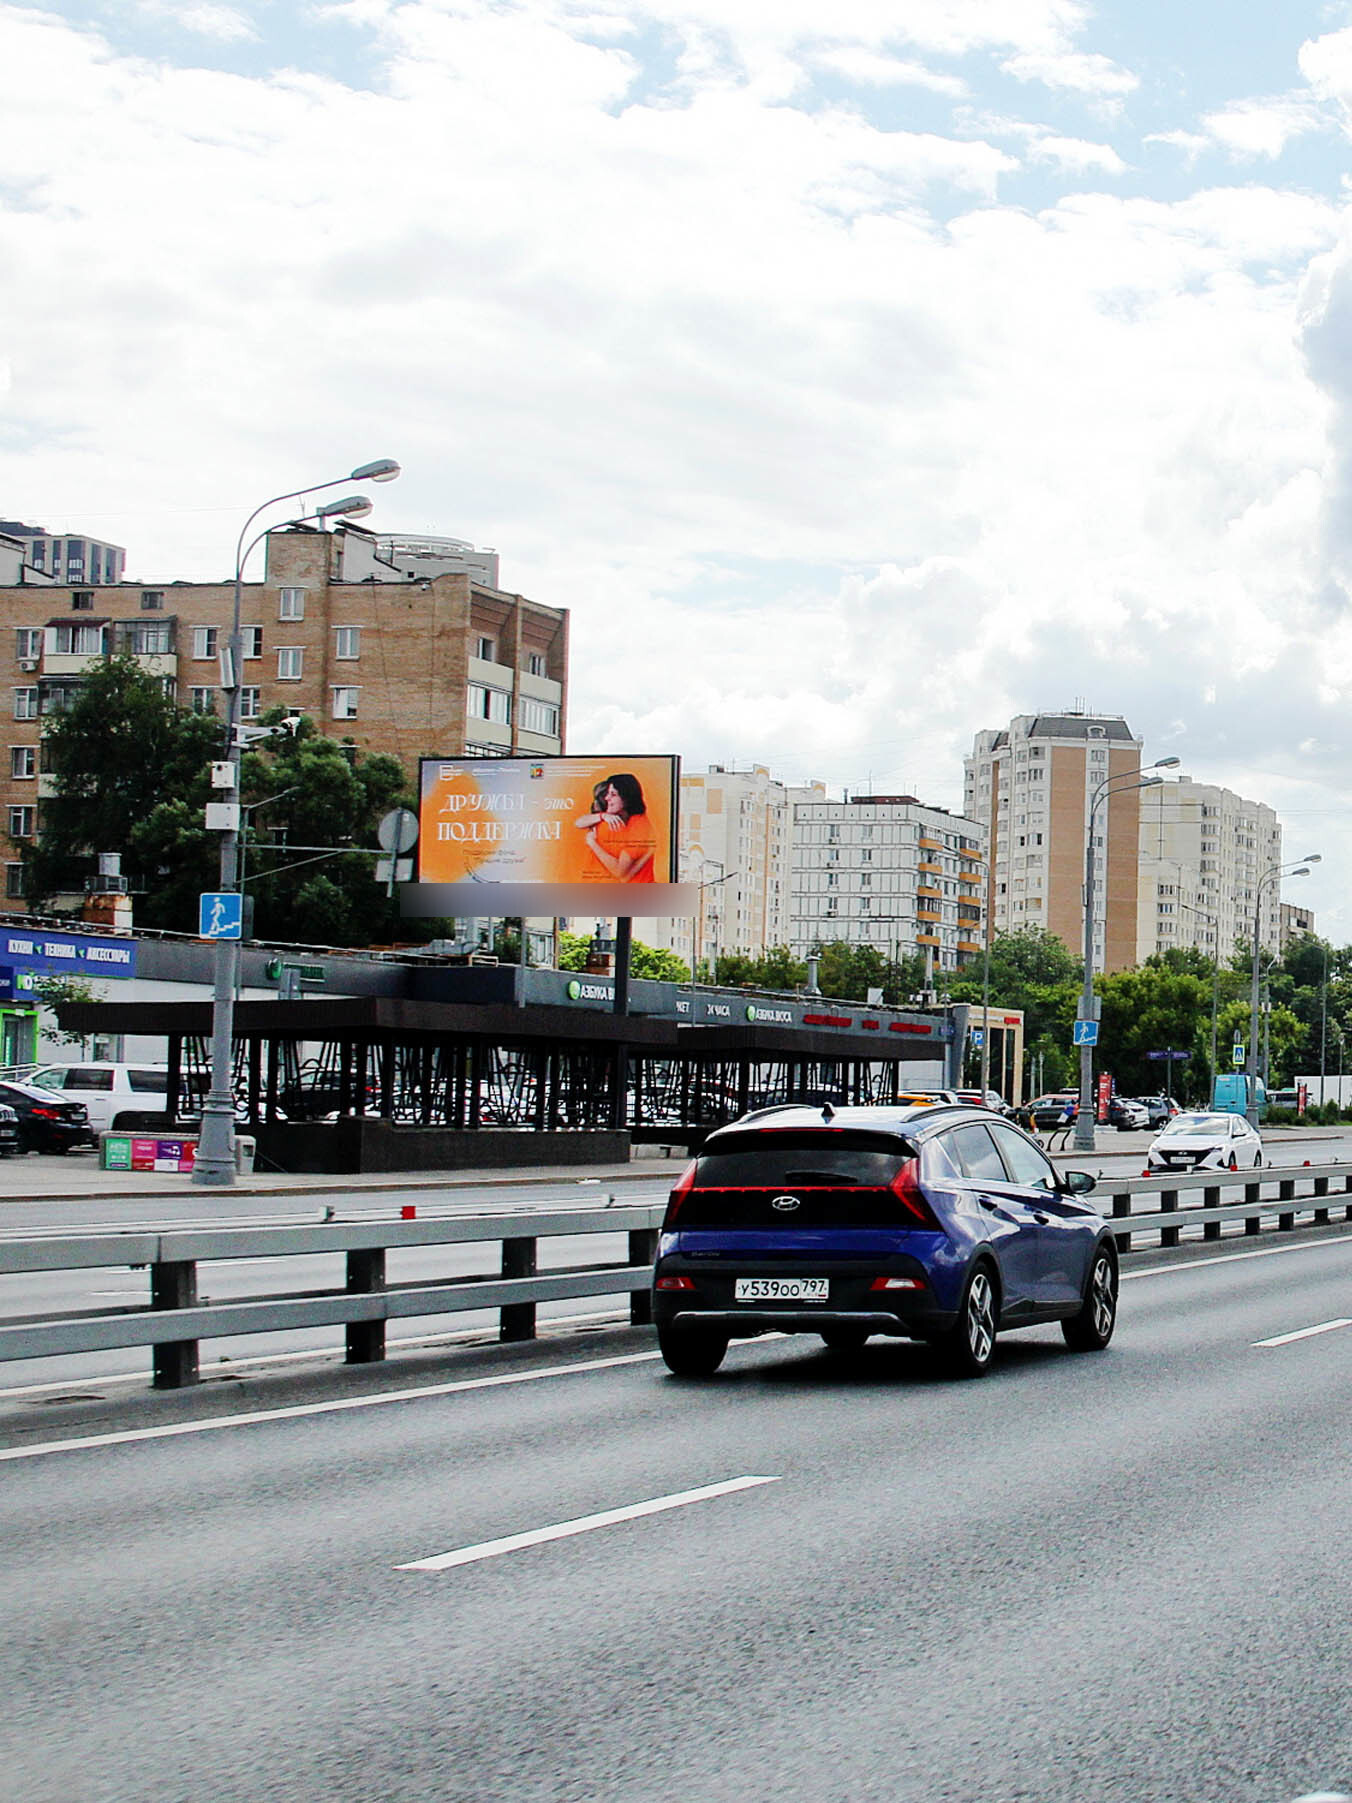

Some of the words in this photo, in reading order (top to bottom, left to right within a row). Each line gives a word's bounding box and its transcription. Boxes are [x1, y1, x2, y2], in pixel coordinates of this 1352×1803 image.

[439, 792, 526, 813] ДРУЖБА
[543, 797, 575, 811] это
[437, 821, 562, 843] ПОДДЕРЖКА
[580, 984, 608, 1001] АЗБУКА
[801, 1280, 826, 1292] 797
